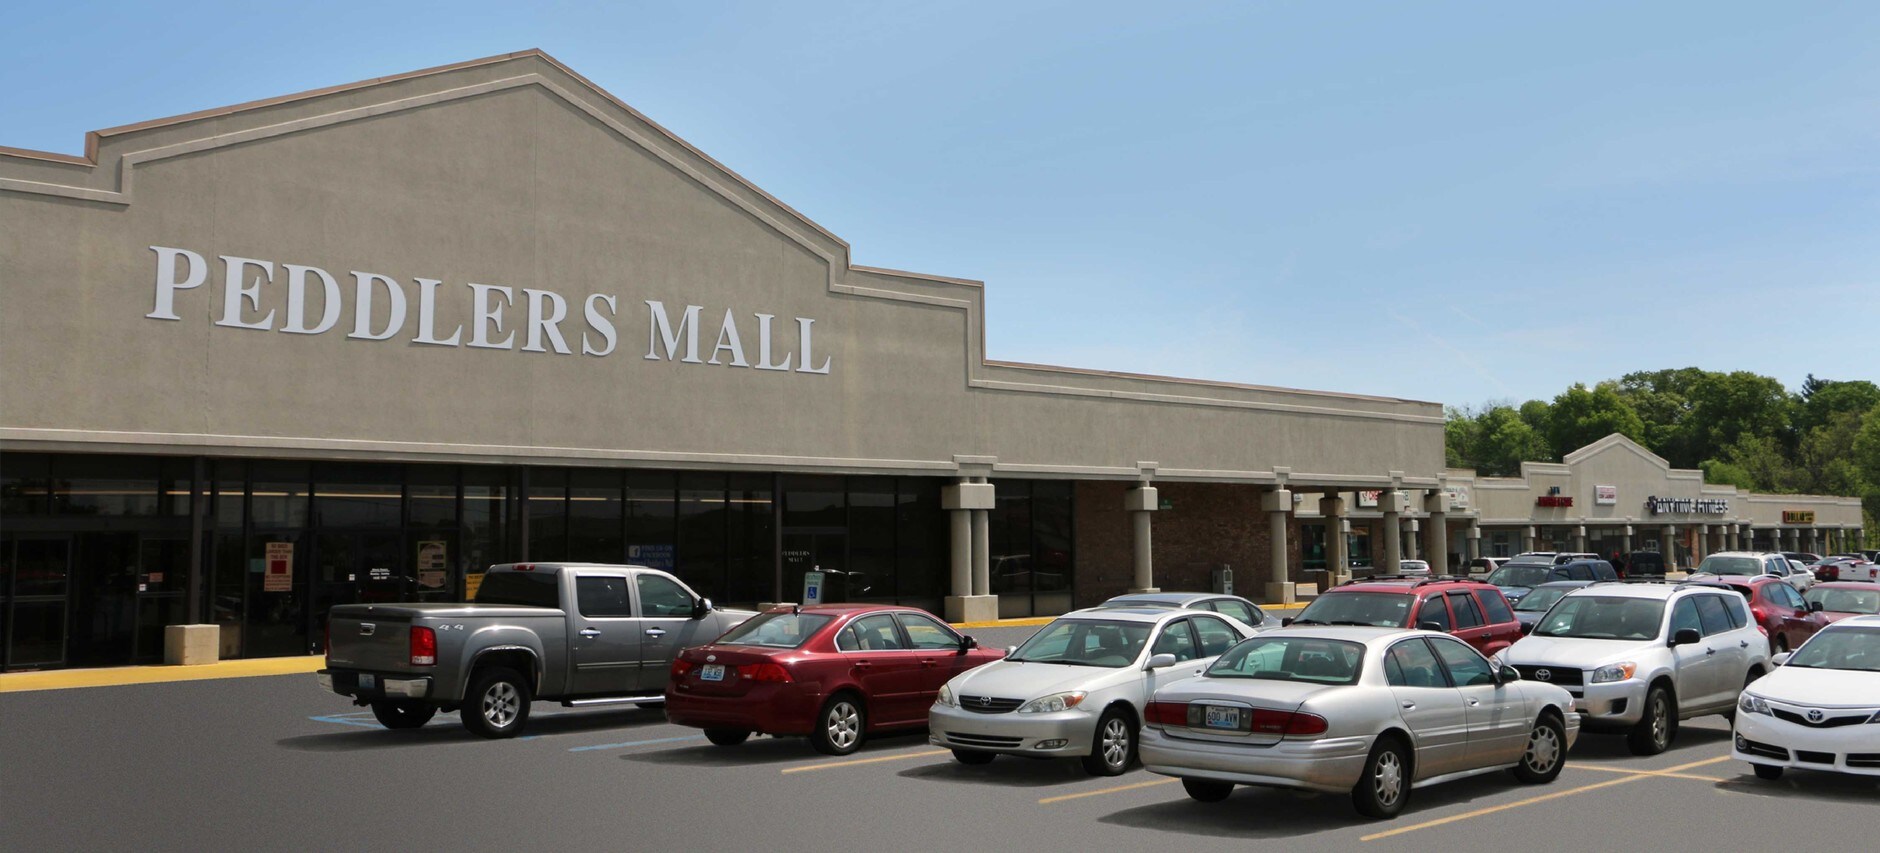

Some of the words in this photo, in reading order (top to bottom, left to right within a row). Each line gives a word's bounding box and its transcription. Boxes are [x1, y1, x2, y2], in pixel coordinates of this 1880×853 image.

[144, 245, 618, 357] PEDDLERS
[644, 299, 832, 375] MALL
[1656, 497, 1696, 513] ANYTIME
[1696, 498, 1729, 514] FITNESS
[1207, 711, 1221, 722] 600
